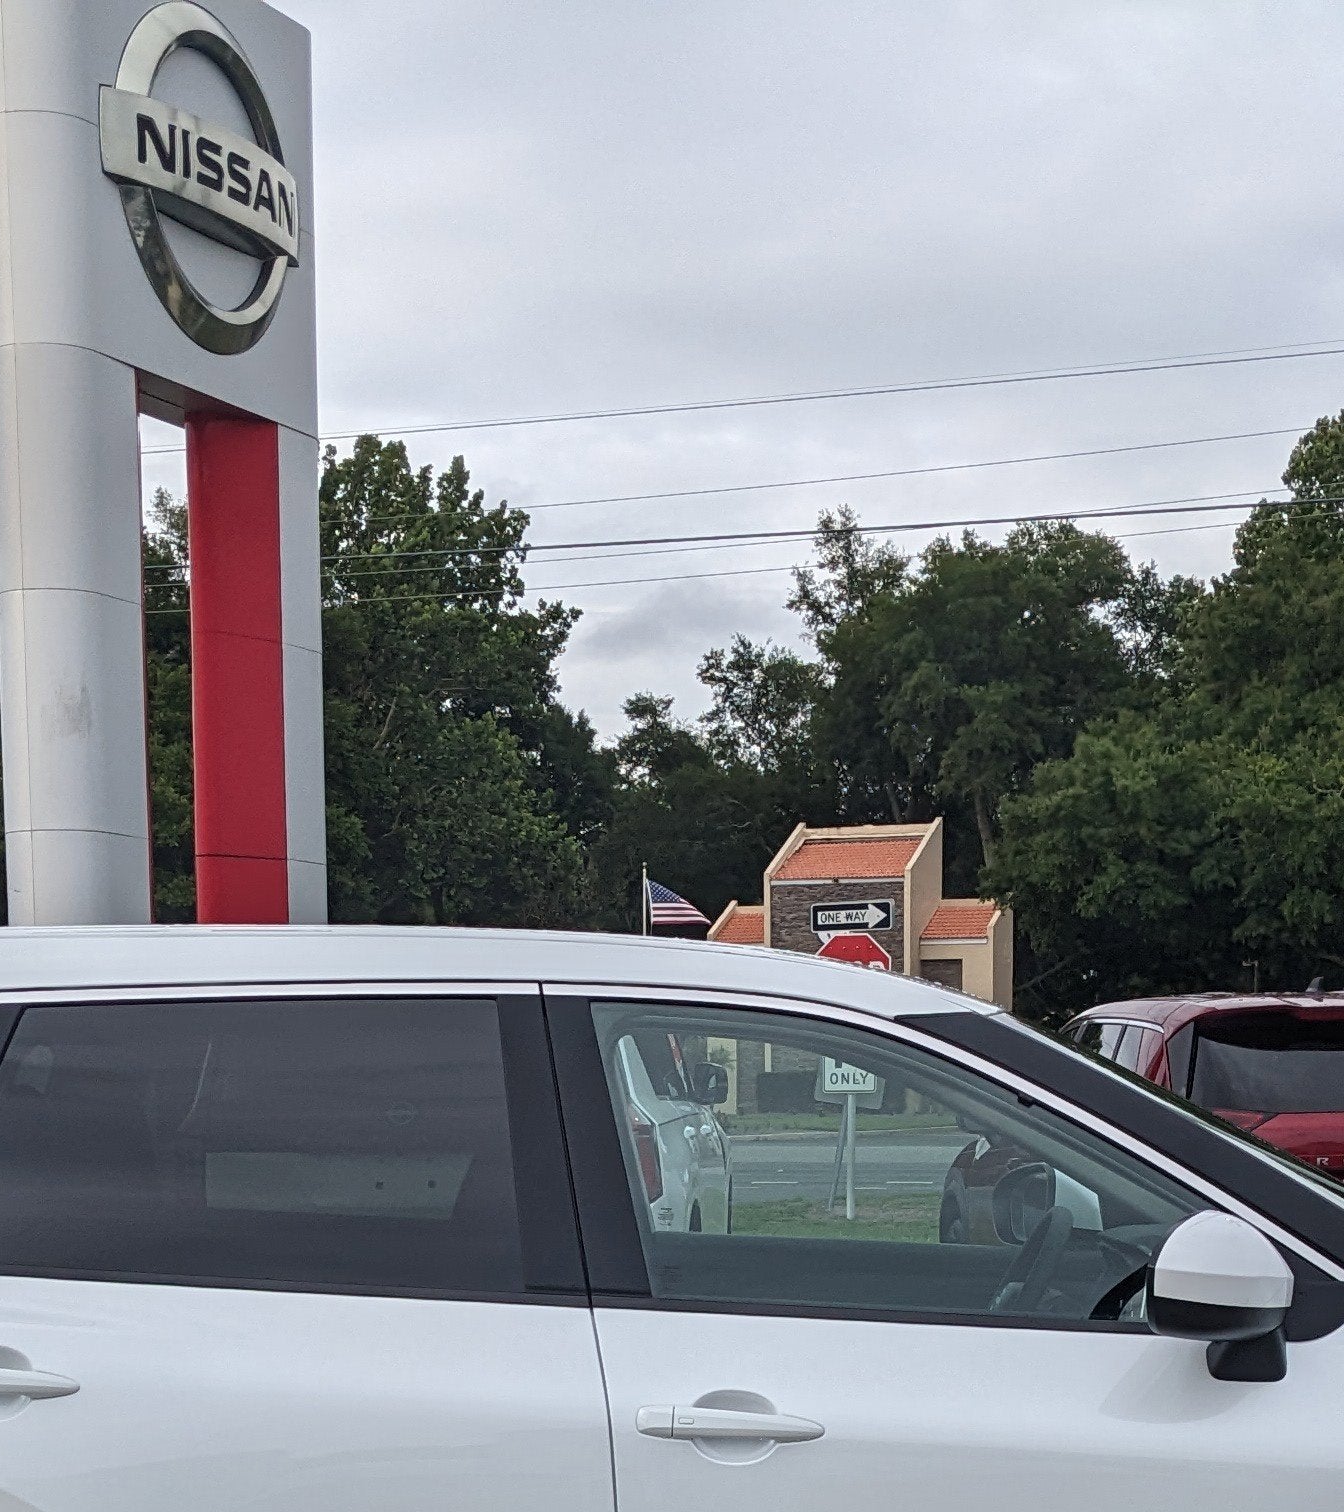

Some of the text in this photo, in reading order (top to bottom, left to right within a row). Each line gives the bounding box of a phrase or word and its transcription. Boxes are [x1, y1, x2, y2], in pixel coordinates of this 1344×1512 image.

[136, 112, 295, 237] NISSAN
[820, 911, 867, 923] ONE WAY
[829, 1072, 868, 1085] ONLY
